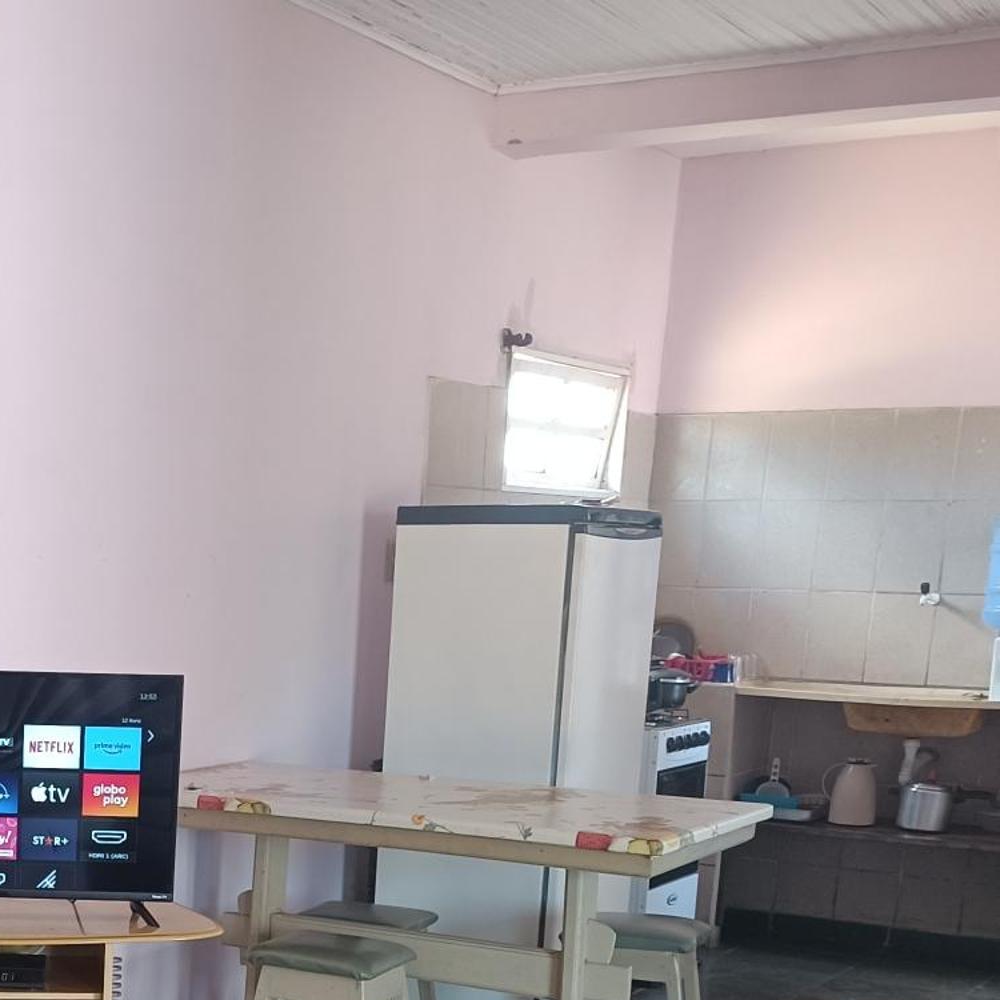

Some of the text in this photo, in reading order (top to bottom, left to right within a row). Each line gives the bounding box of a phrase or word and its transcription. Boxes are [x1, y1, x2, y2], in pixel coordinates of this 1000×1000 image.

[29, 740, 74, 753] NETFLIX
[94, 742, 132, 750] prime video
[50, 784, 70, 803] tv
[93, 784, 126, 796] globo
[103, 793, 129, 808] play
